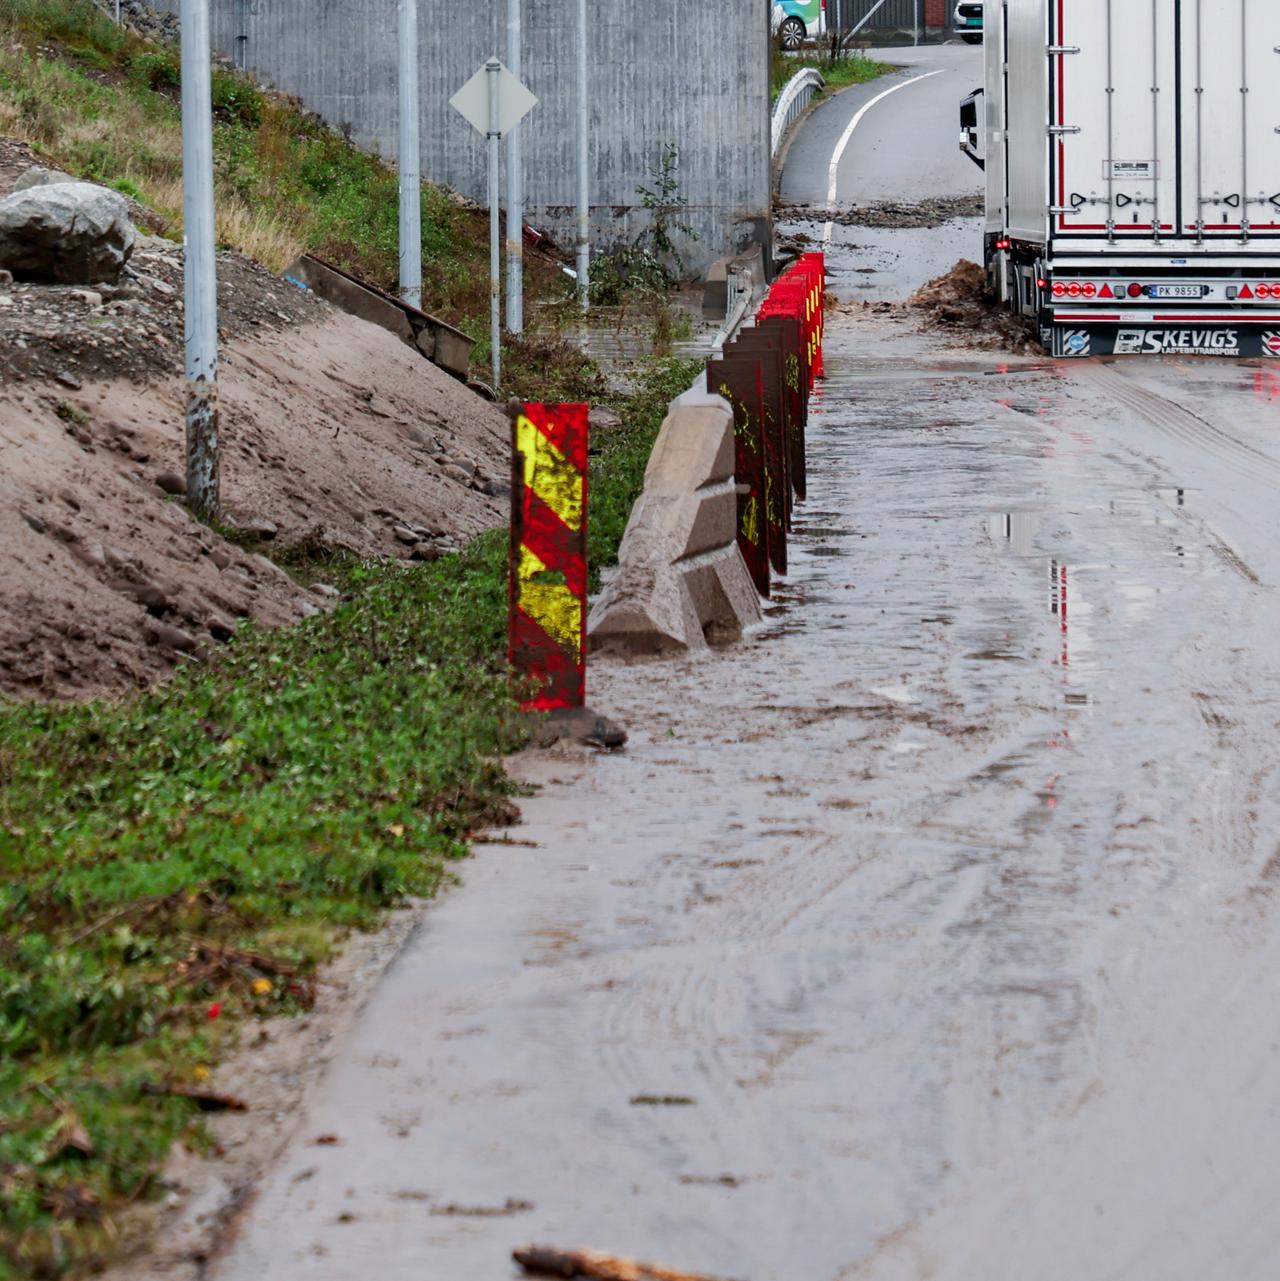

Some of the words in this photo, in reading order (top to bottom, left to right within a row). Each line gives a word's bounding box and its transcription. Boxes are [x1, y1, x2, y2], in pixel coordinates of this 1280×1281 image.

[1159, 286, 1171, 296] PK
[1174, 286, 1198, 296] 9855
[1141, 328, 1238, 354] SKEVIG'S
